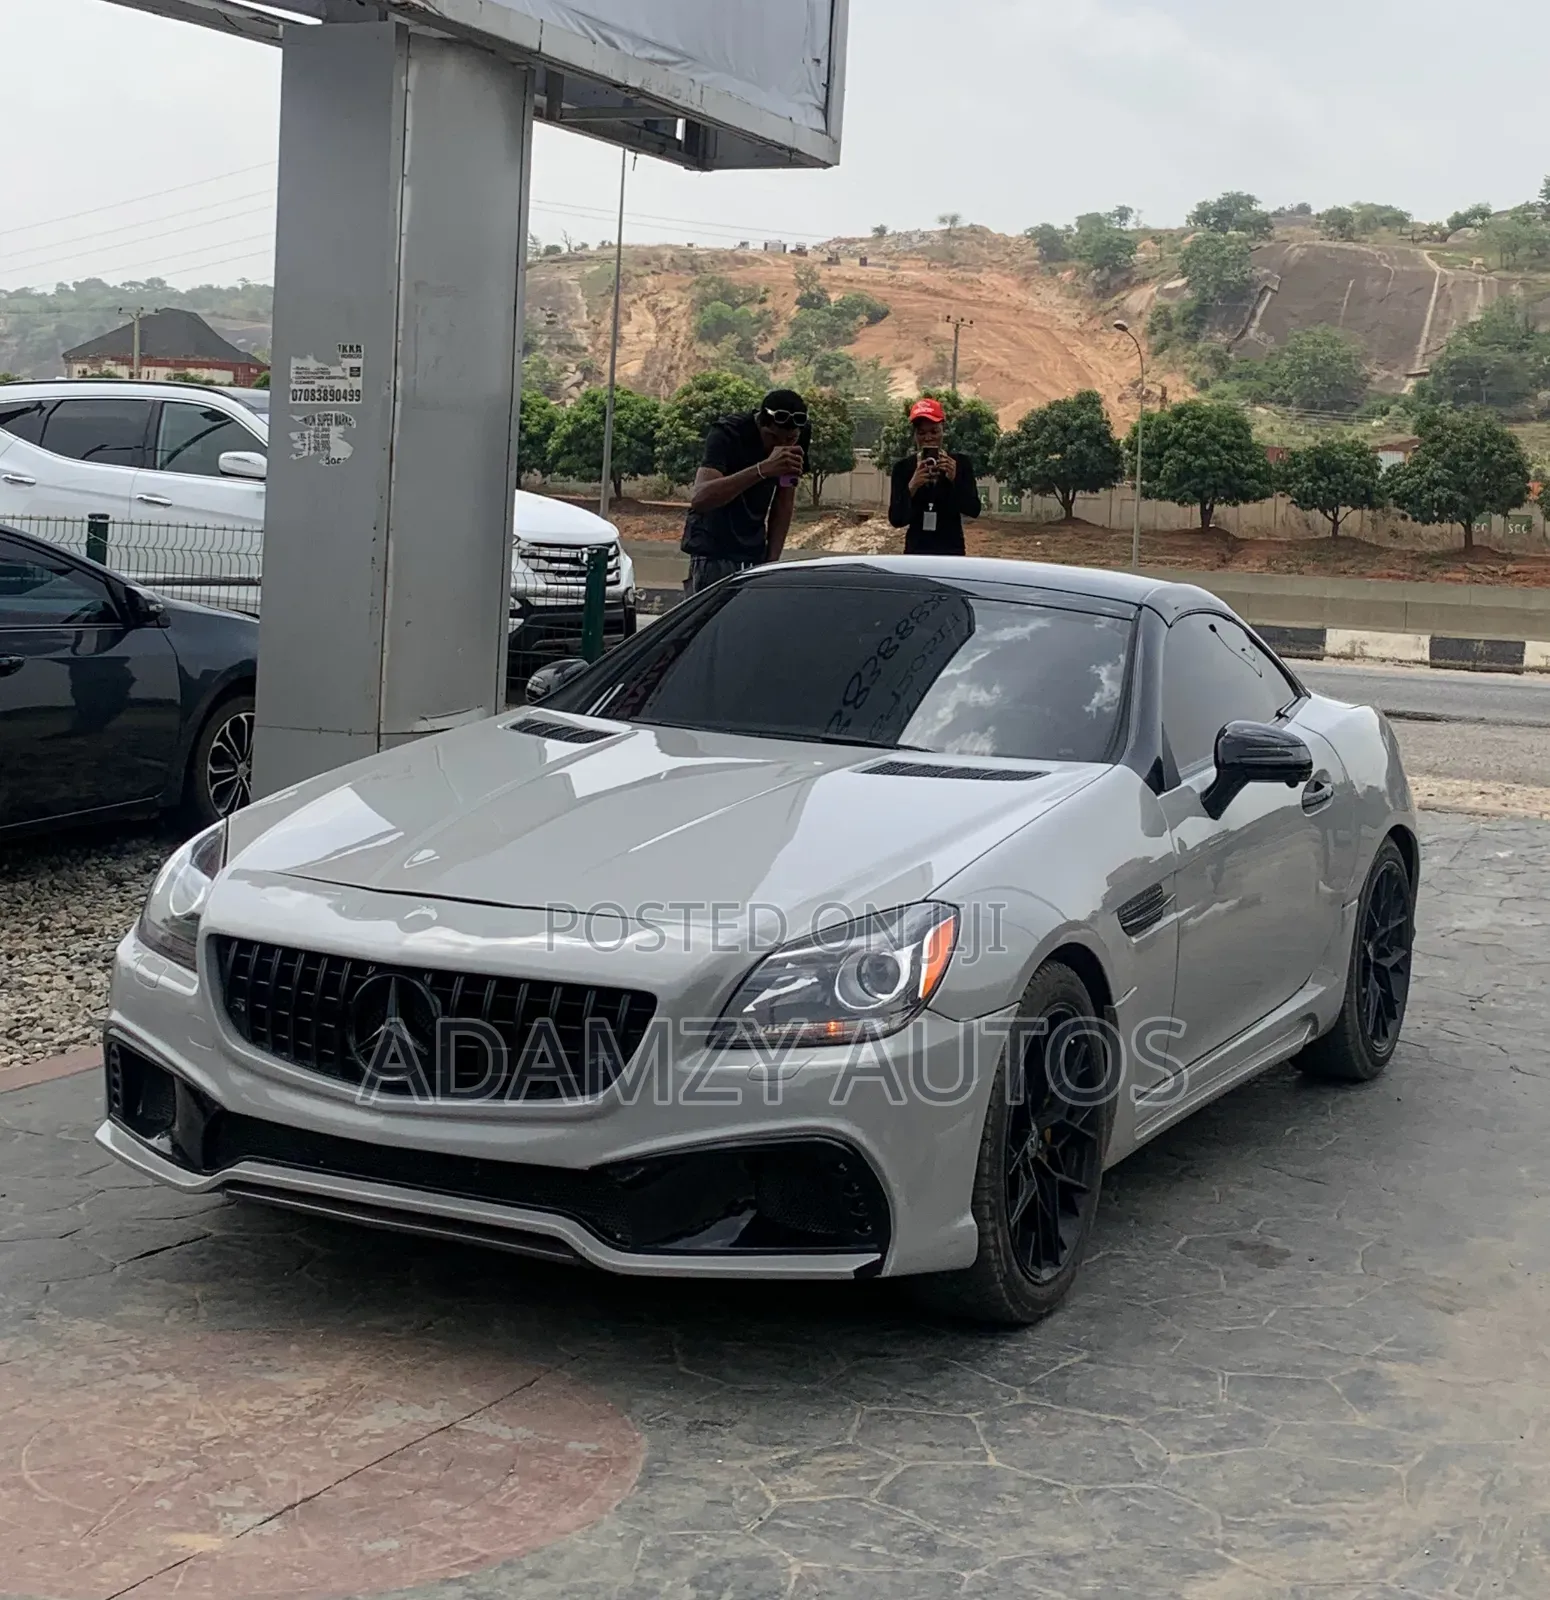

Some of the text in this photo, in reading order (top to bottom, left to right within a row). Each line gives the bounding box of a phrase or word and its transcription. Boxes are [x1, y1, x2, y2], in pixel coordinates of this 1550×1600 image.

[291, 389, 361, 402] 07083890499
[1002, 495, 1019, 505] SCC
[1508, 523, 1528, 534] SCC
